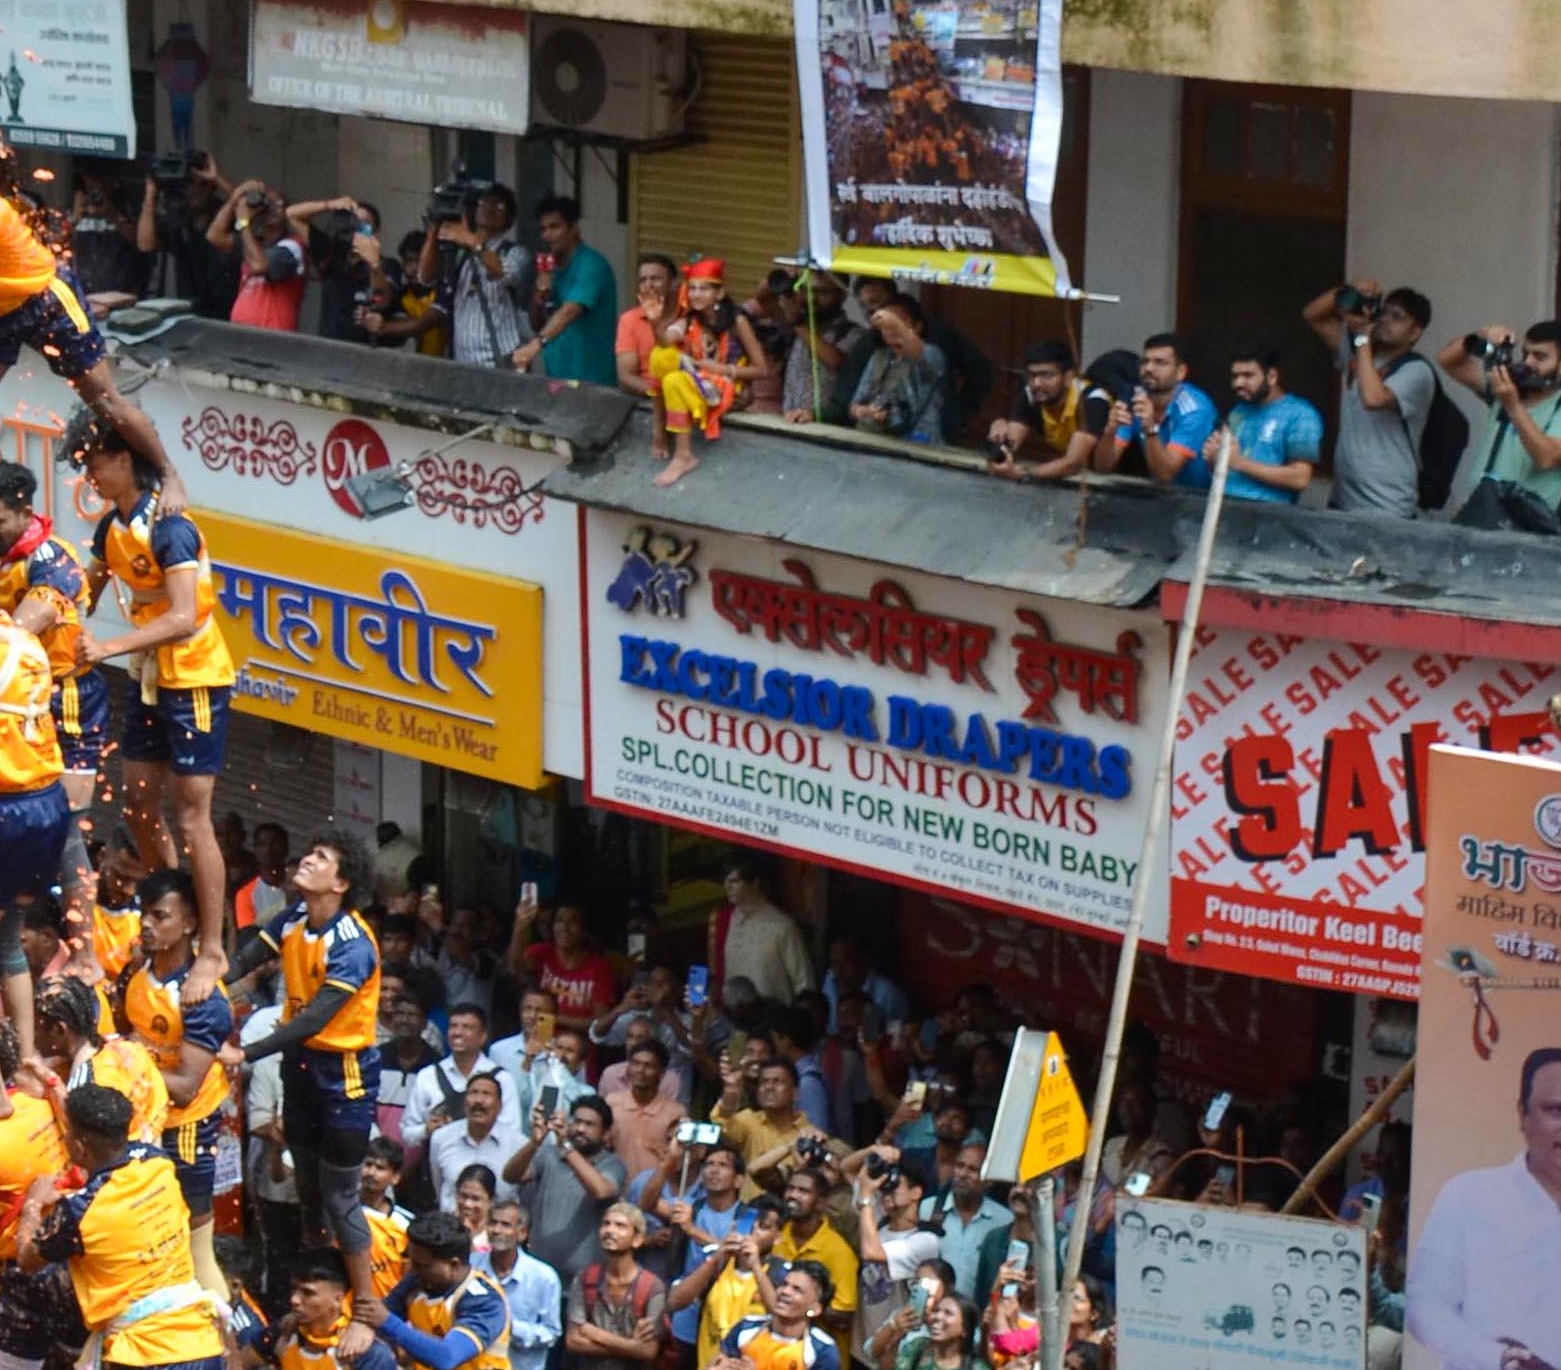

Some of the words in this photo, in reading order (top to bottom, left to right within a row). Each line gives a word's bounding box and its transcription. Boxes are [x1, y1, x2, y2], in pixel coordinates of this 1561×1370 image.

[211, 567, 496, 699] महावीर
[312, 690, 370, 729] Ethnic
[375, 706, 392, 735] &
[399, 710, 452, 750] Men's
[453, 725, 499, 762] Wear
[618, 634, 878, 743] EXCELSIOR
[886, 694, 1133, 801] DRAPERS
[655, 698, 831, 772] SCHOOL
[847, 742, 1098, 837] UNIFORMS
[616, 768, 703, 801] COMPOSITION
[706, 790, 762, 817] TAXABLE
[766, 805, 820, 831] PERSON
[823, 820, 851, 839] NOT
[854, 826, 915, 856] ELIGIBLE
[919, 843, 938, 860] TO
[940, 849, 1003, 877] COLLECT
[1008, 866, 1035, 886] TAX
[1038, 875, 1060, 894] ON
[1063, 883, 1134, 913] SUPPLIES
[621, 736, 833, 811] SPL.COLLECTION
[842, 790, 895, 828] FOR
[903, 804, 964, 844] NEW
[972, 821, 1051, 868] BORN
[1060, 844, 1139, 889] BABY
[1205, 895, 1318, 937] Properitor
[1324, 915, 1376, 946] Keel
[1455, 892, 1524, 926] माहिम
